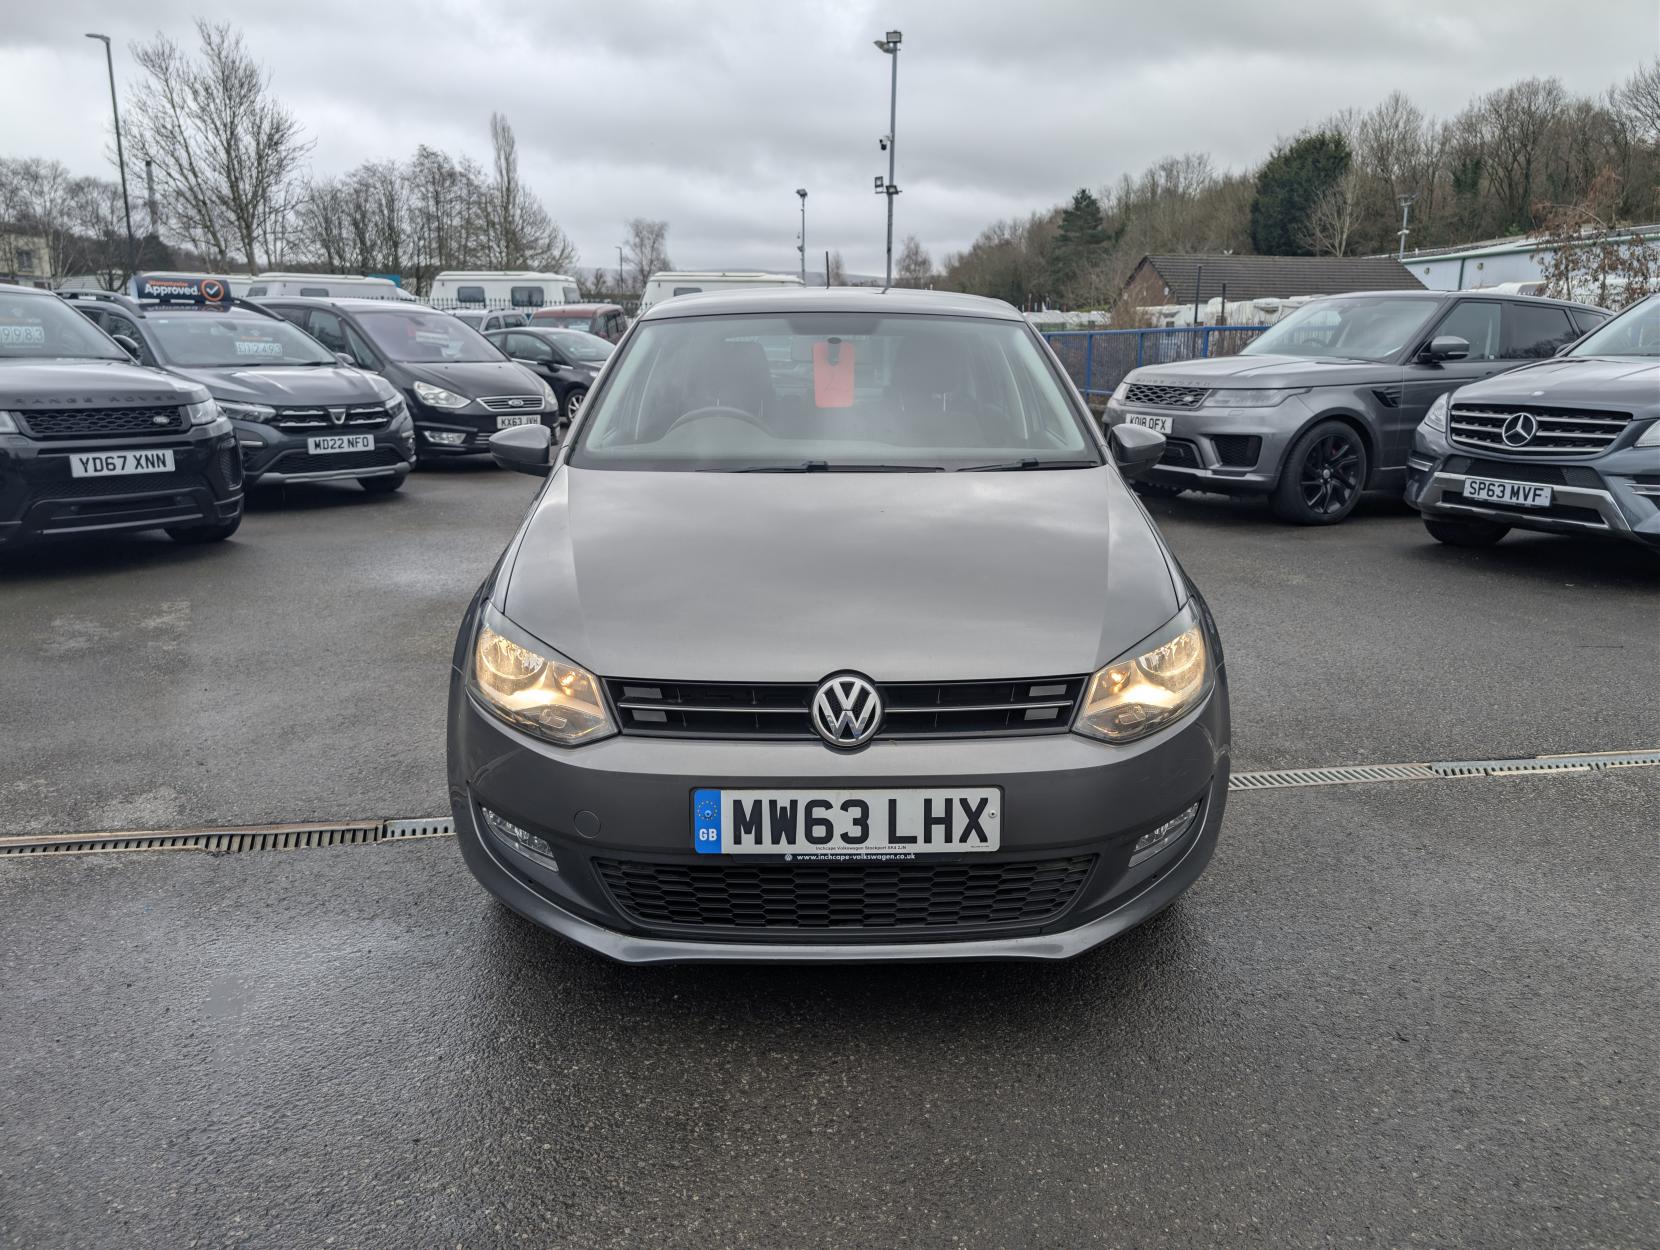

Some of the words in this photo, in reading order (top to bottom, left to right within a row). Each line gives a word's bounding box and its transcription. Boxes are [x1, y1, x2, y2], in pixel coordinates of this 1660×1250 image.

[314, 437, 345, 450] MD22
[347, 436, 369, 448] NFO
[79, 455, 127, 473] YD67
[133, 453, 167, 470] XNN
[1469, 481, 1506, 499] SP63
[1510, 485, 1544, 502] MVF
[733, 799, 870, 845] MW63
[888, 797, 989, 844] LHX
[699, 828, 718, 841] GB
[796, 853, 916, 861] www.inchcape-volkswagen.co.uk
